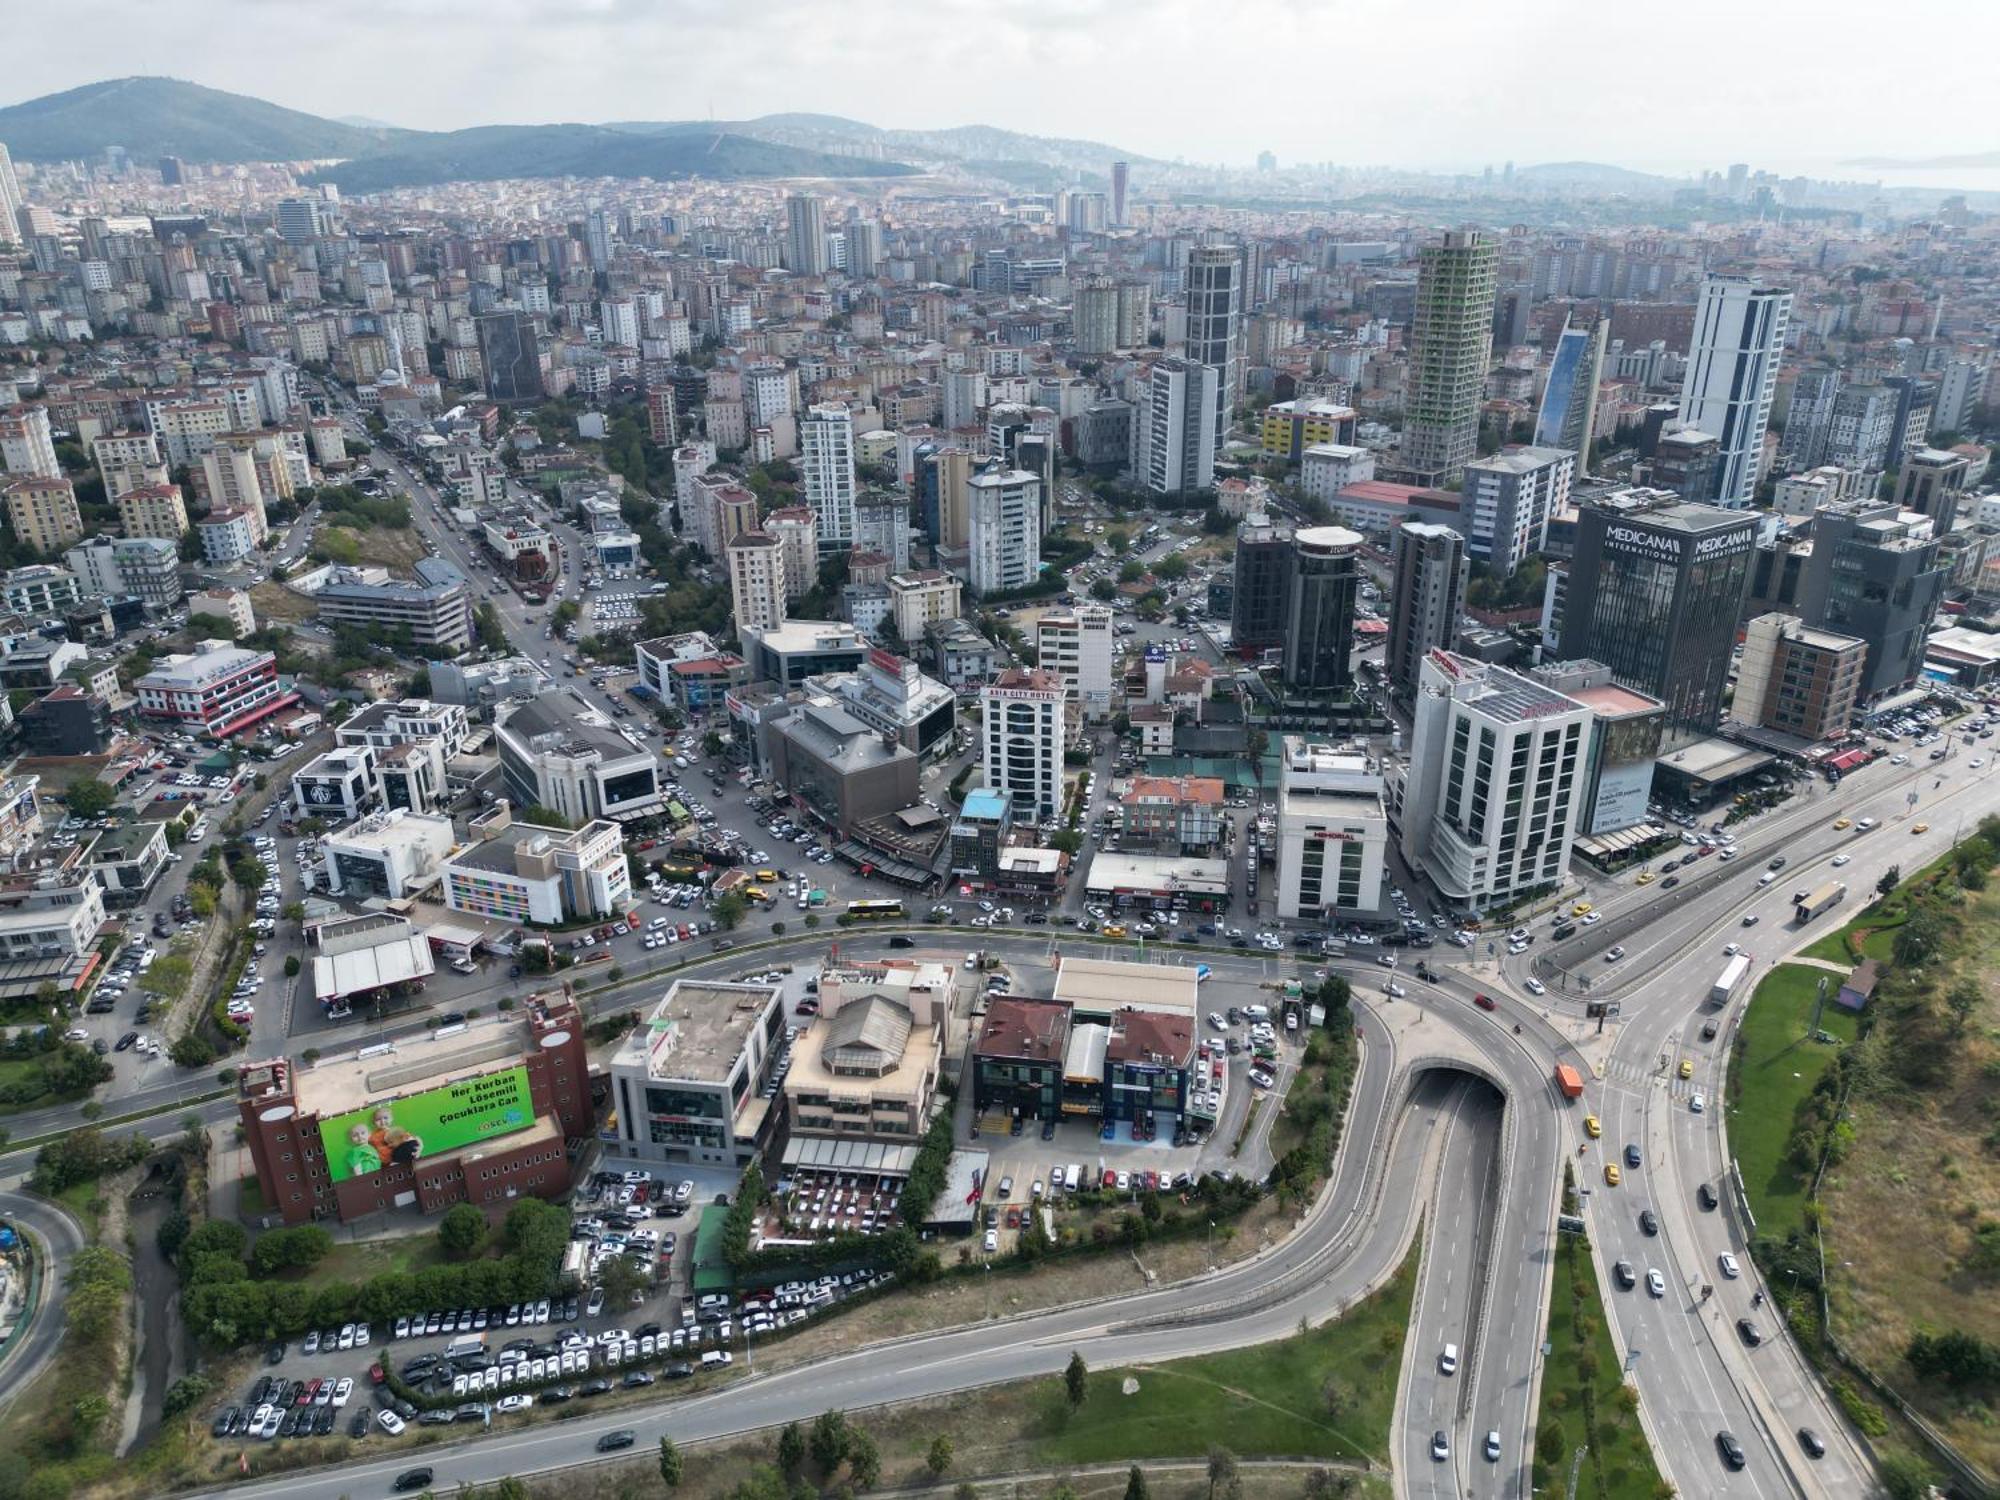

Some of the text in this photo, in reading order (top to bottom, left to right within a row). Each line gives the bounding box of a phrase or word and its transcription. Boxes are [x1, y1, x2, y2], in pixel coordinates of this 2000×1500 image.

[1606, 526, 1674, 553] MEDICANA
[1695, 529, 1746, 555] MEDICANA
[1604, 540, 1679, 563] INTERNATIONAL
[1693, 544, 1750, 563] INTERNATIONAL
[1010, 690, 1028, 698] CITY
[1030, 691, 1056, 700] HOTEL
[1314, 831, 1355, 841] MEMORIAL
[451, 1075, 516, 1098] Her Kurban
[469, 1084, 517, 1104] Lösemili
[439, 1095, 519, 1125] Çocuklara Can
